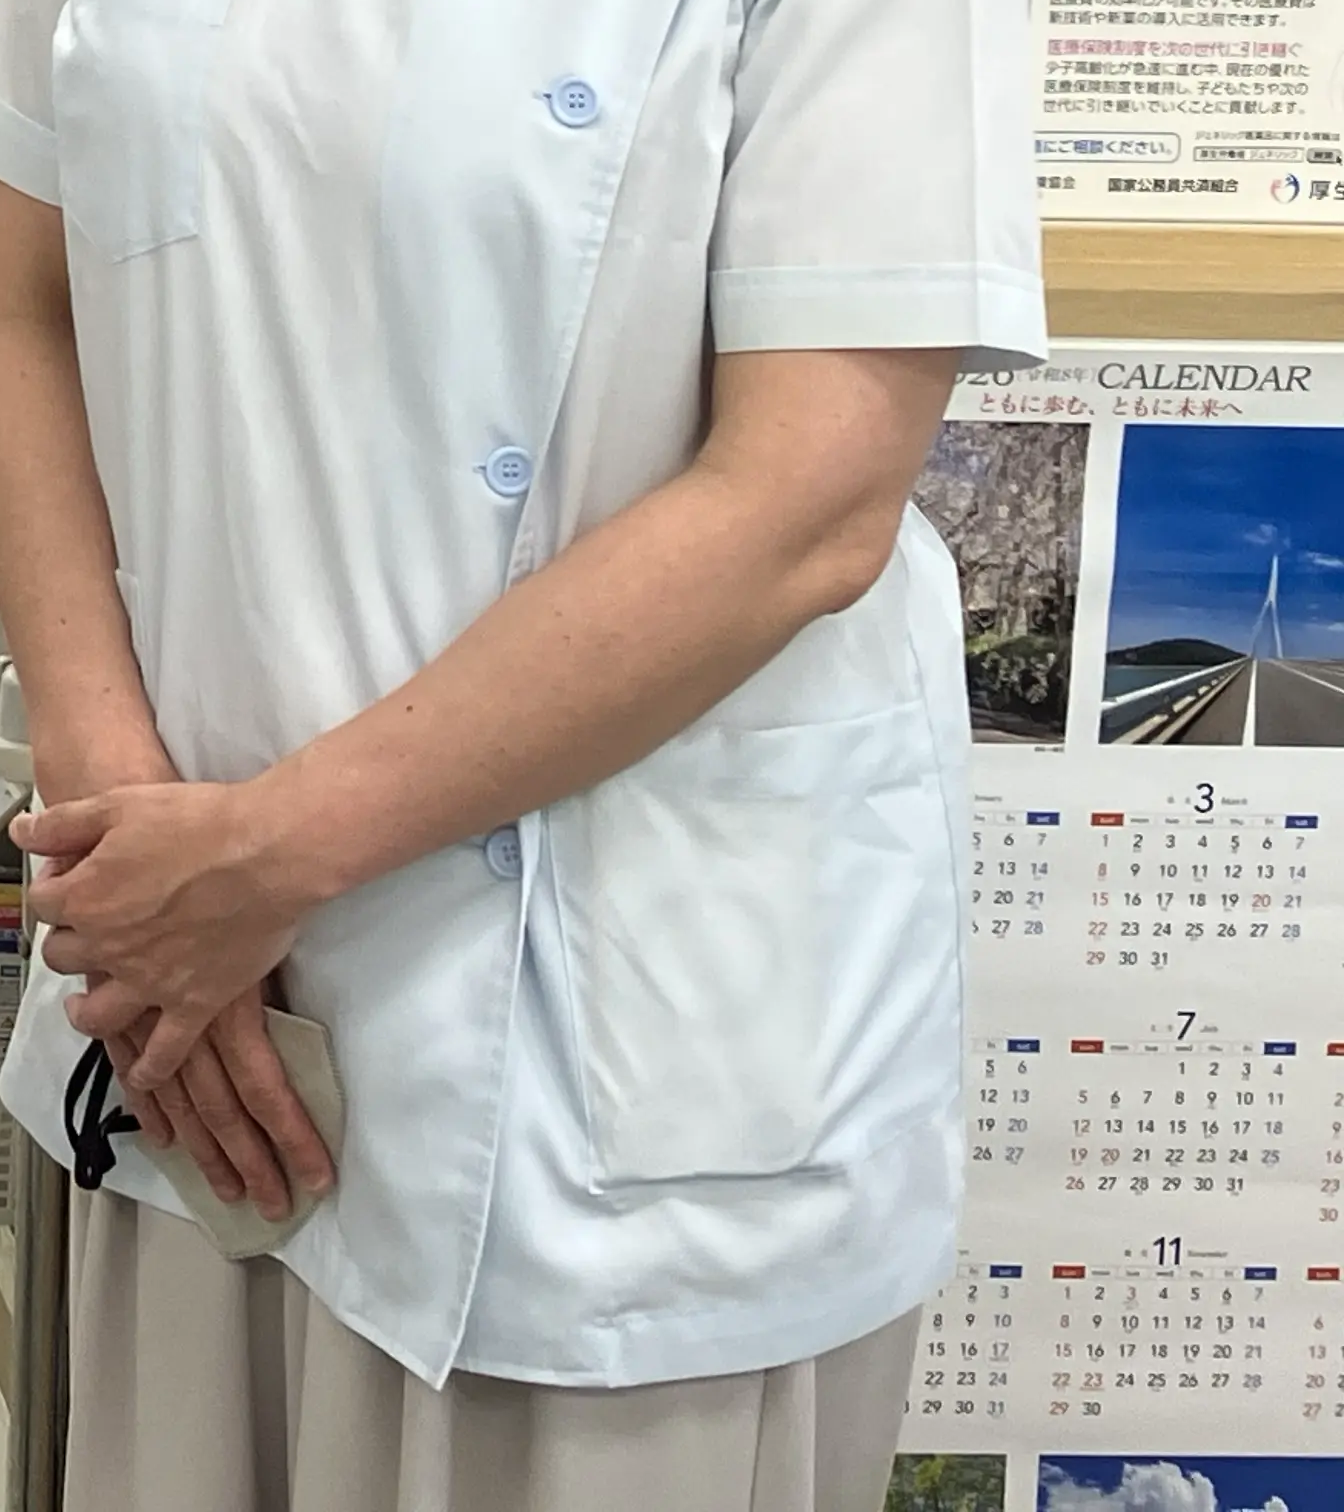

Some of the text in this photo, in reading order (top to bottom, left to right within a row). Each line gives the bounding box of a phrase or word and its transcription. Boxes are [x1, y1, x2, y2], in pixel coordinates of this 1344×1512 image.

[1097, 362, 1312, 393] CALENDAR
[979, 393, 1243, 417] ともに歩む、 ともに未来へ
[1193, 782, 1215, 815] 3
[1102, 833, 1305, 850] 1 2 3 4 5 6 7
[1097, 862, 1306, 879] 8 9 10 11 12 13 14
[1092, 891, 1302, 908] 15 16 17 18 19 20 21
[1087, 921, 1301, 939] 22 23 24 25 26 27 28
[1086, 950, 1168, 966] 29 30 31
[1176, 1010, 1197, 1041] 7
[1078, 1089, 1284, 1106] 5 6 7 8 9 10 11
[1065, 1175, 1244, 1192] 26 27 28 29 30 31
[1153, 1236, 1182, 1266] 11
[1059, 1314, 1266, 1331] 8 9 10 11 12 13 14
[1051, 1372, 1263, 1388] 22 23 24 25 26 27 28
